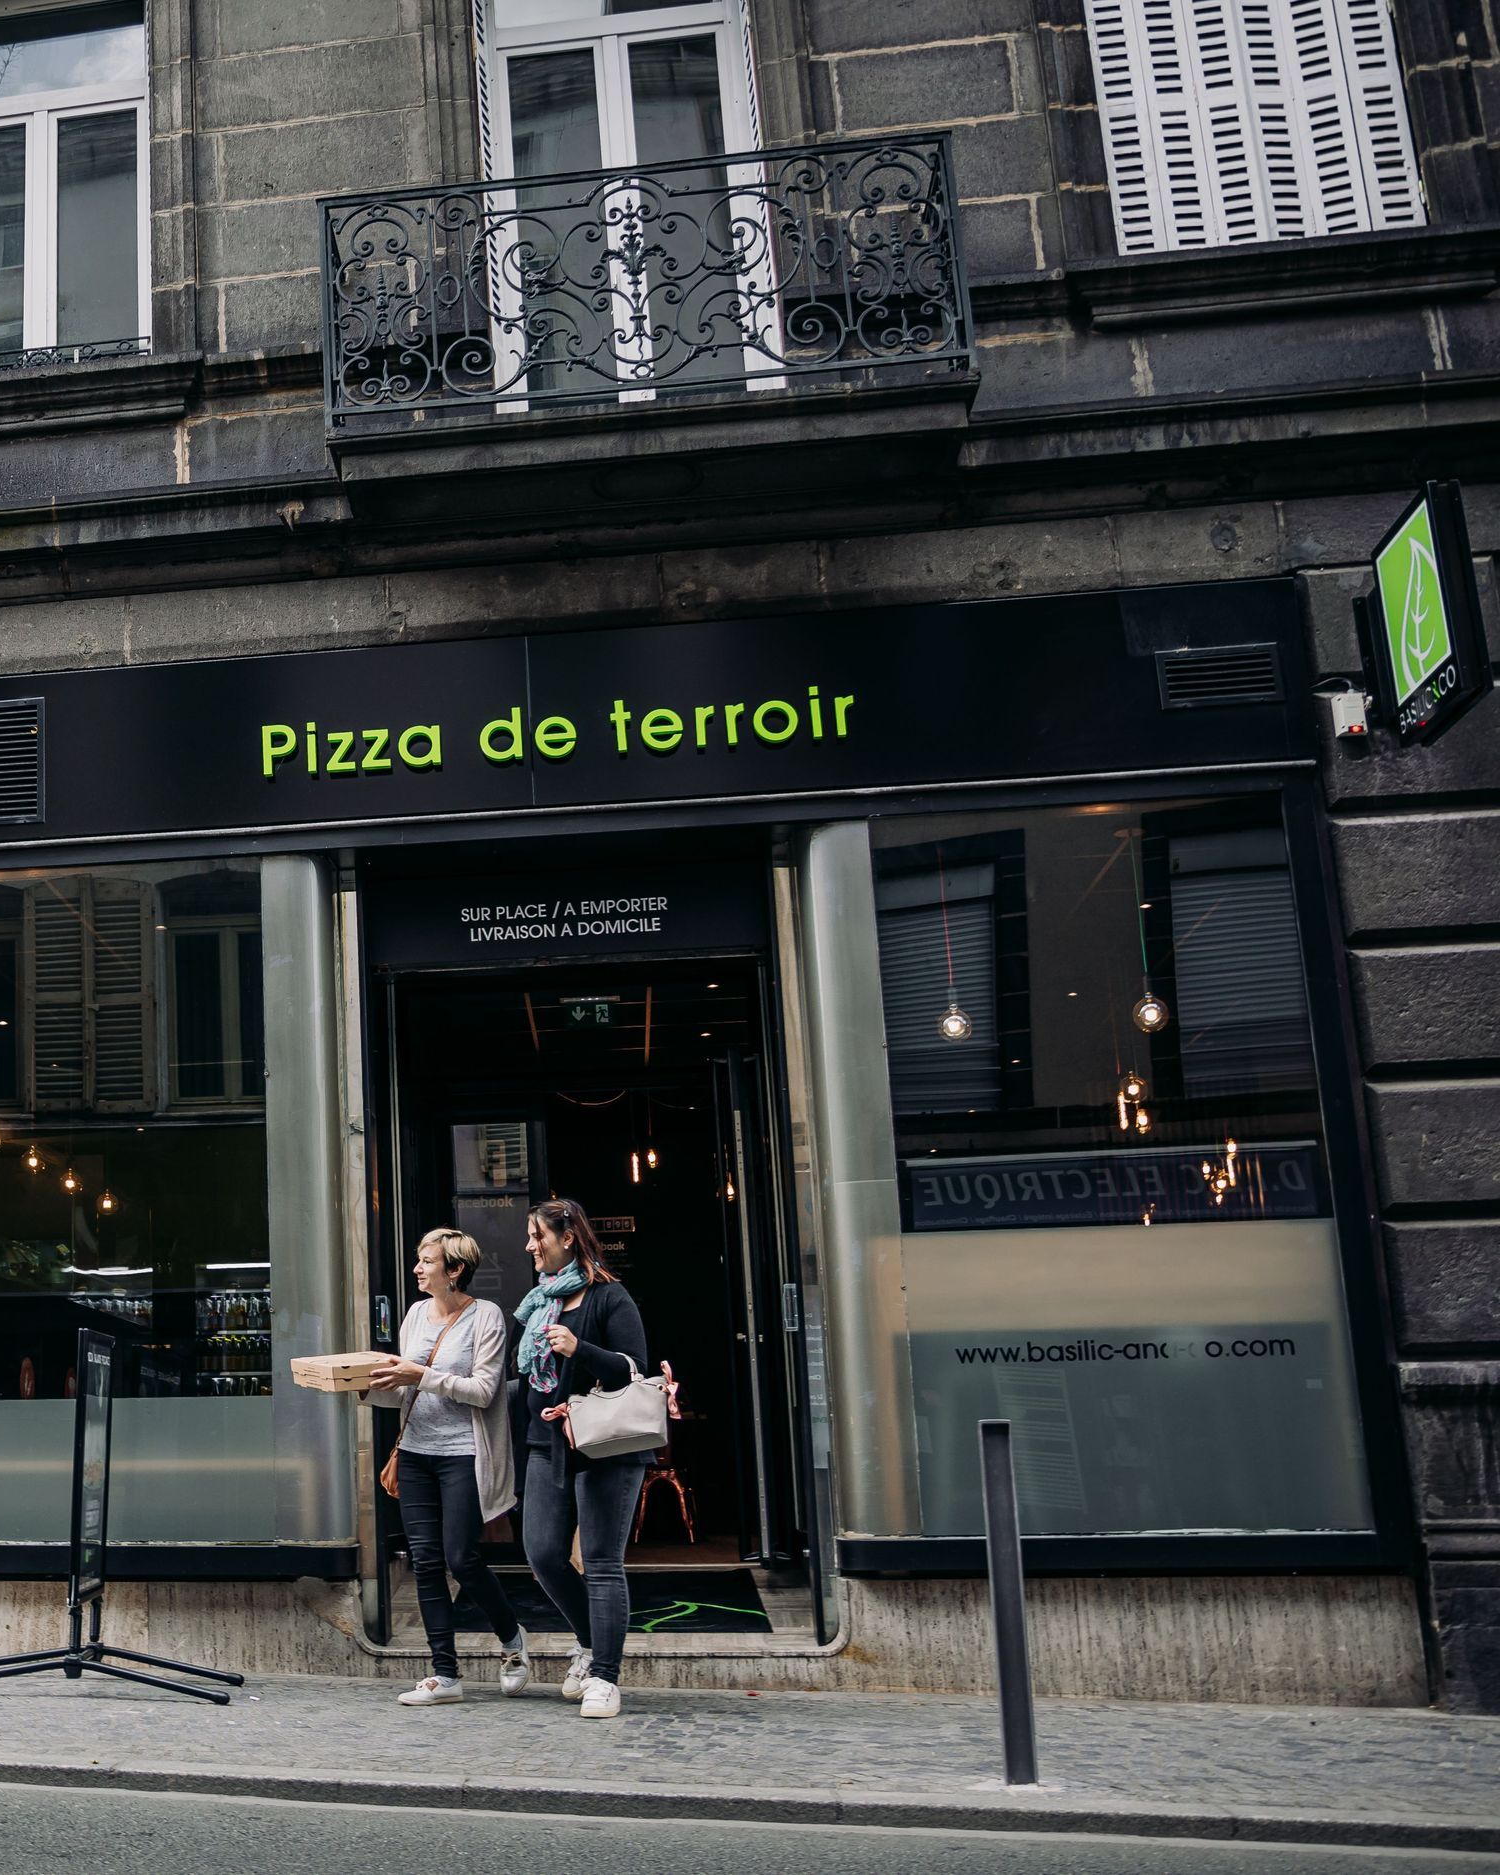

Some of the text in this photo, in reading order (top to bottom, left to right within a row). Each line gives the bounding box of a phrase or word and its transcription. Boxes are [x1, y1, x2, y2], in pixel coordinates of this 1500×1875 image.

[261, 685, 855, 778] Pizza de terroir
[461, 907, 491, 922] SUR
[496, 904, 548, 920] PLACE
[564, 902, 577, 917] A
[581, 896, 669, 915] EMPORTER
[470, 917, 662, 942] LIVRAISON A DOMICILE
